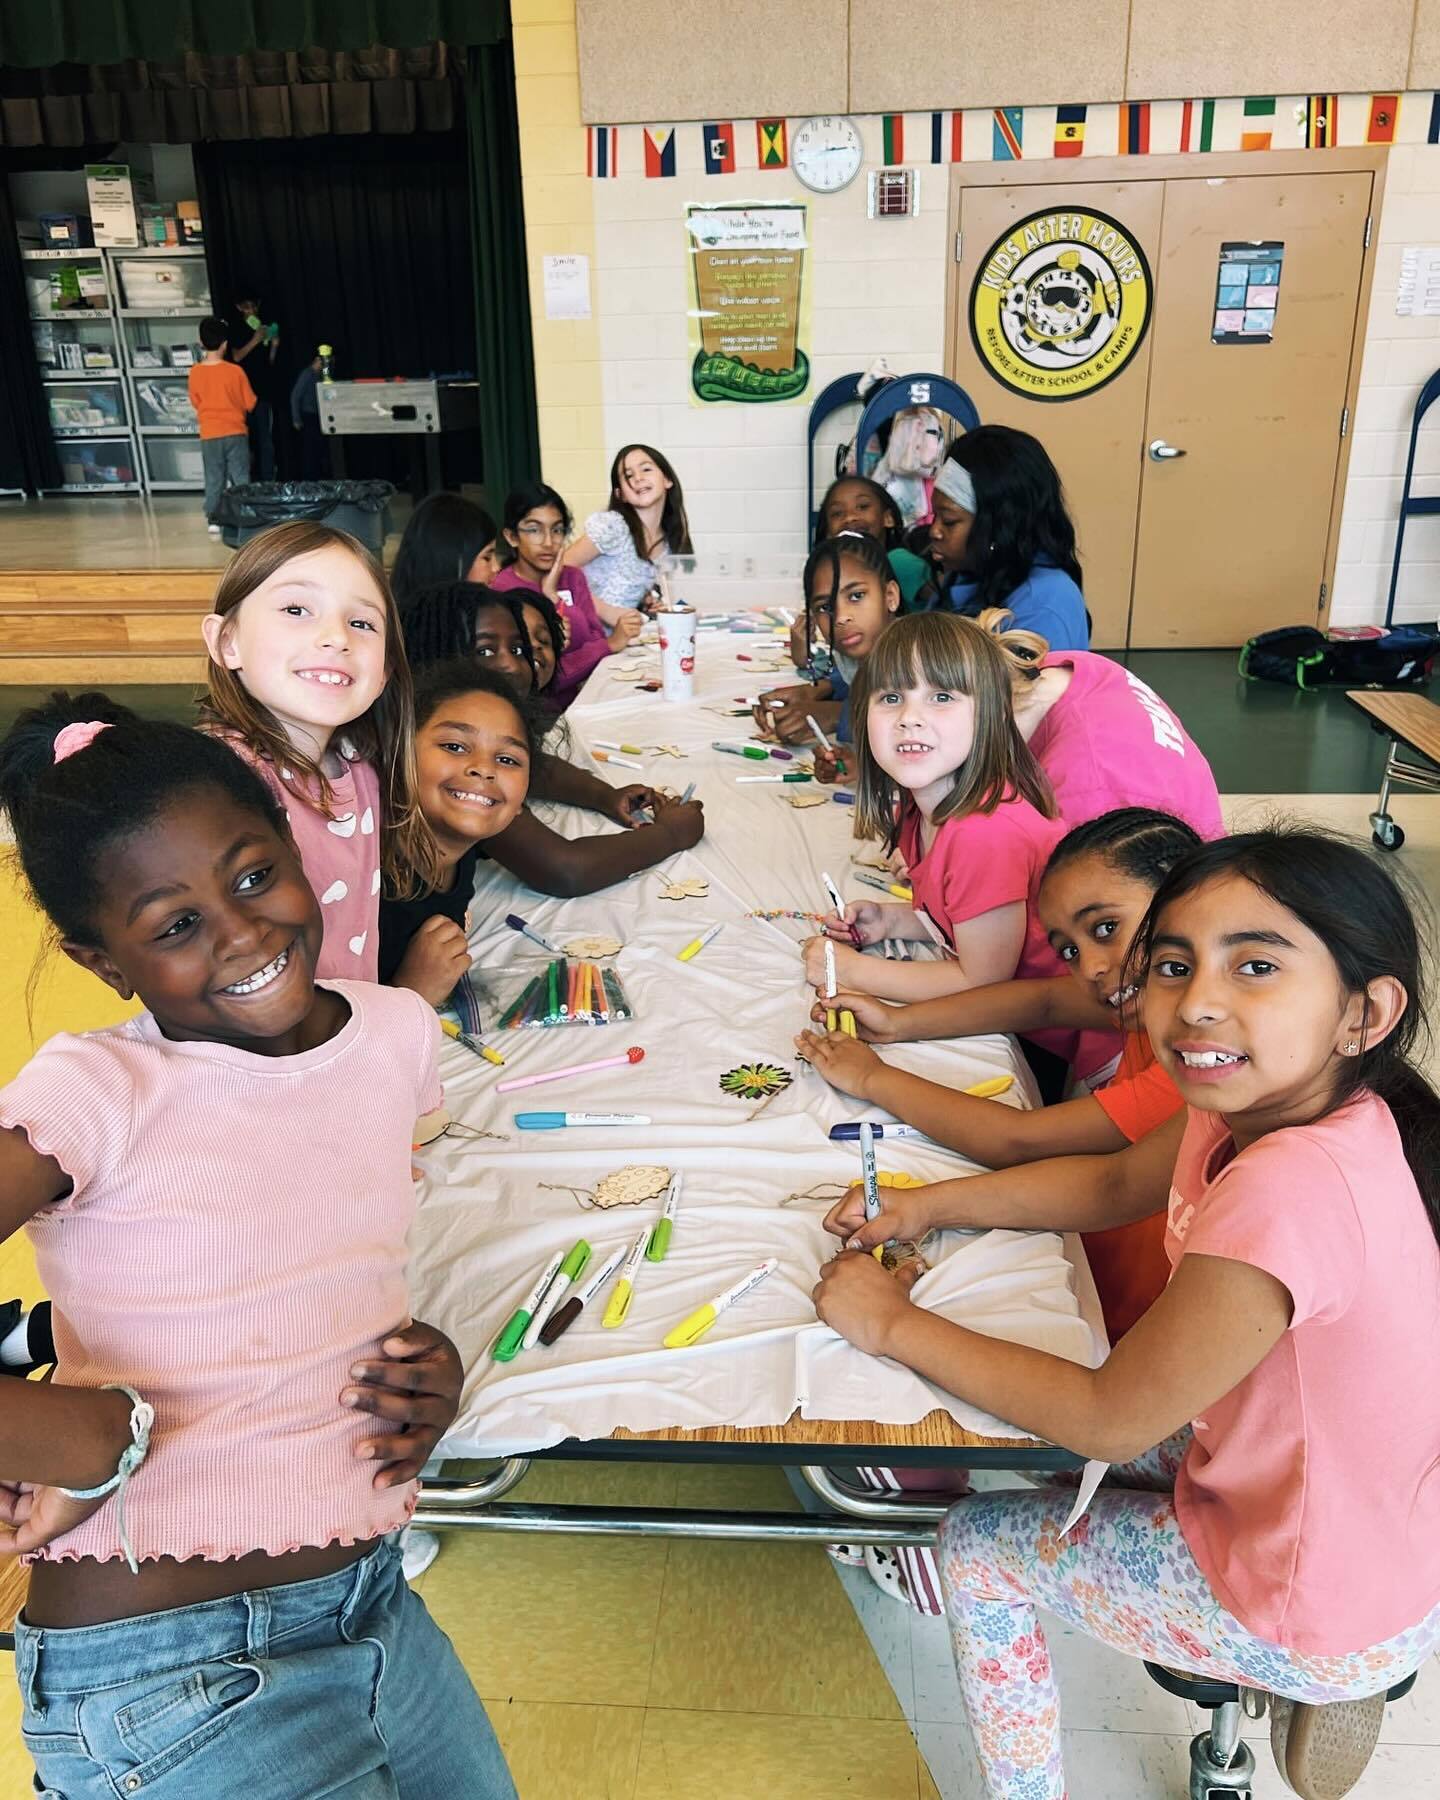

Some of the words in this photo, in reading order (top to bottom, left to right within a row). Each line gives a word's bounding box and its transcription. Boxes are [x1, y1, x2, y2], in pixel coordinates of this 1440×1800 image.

[982, 240, 1023, 290] KIDS
[1024, 216, 1082, 248] AFTER
[1087, 222, 1143, 285] HOURS
[1047, 369, 1094, 387] SCHOOL
[1104, 326, 1133, 364] CAMPS
[910, 383, 931, 404] S
